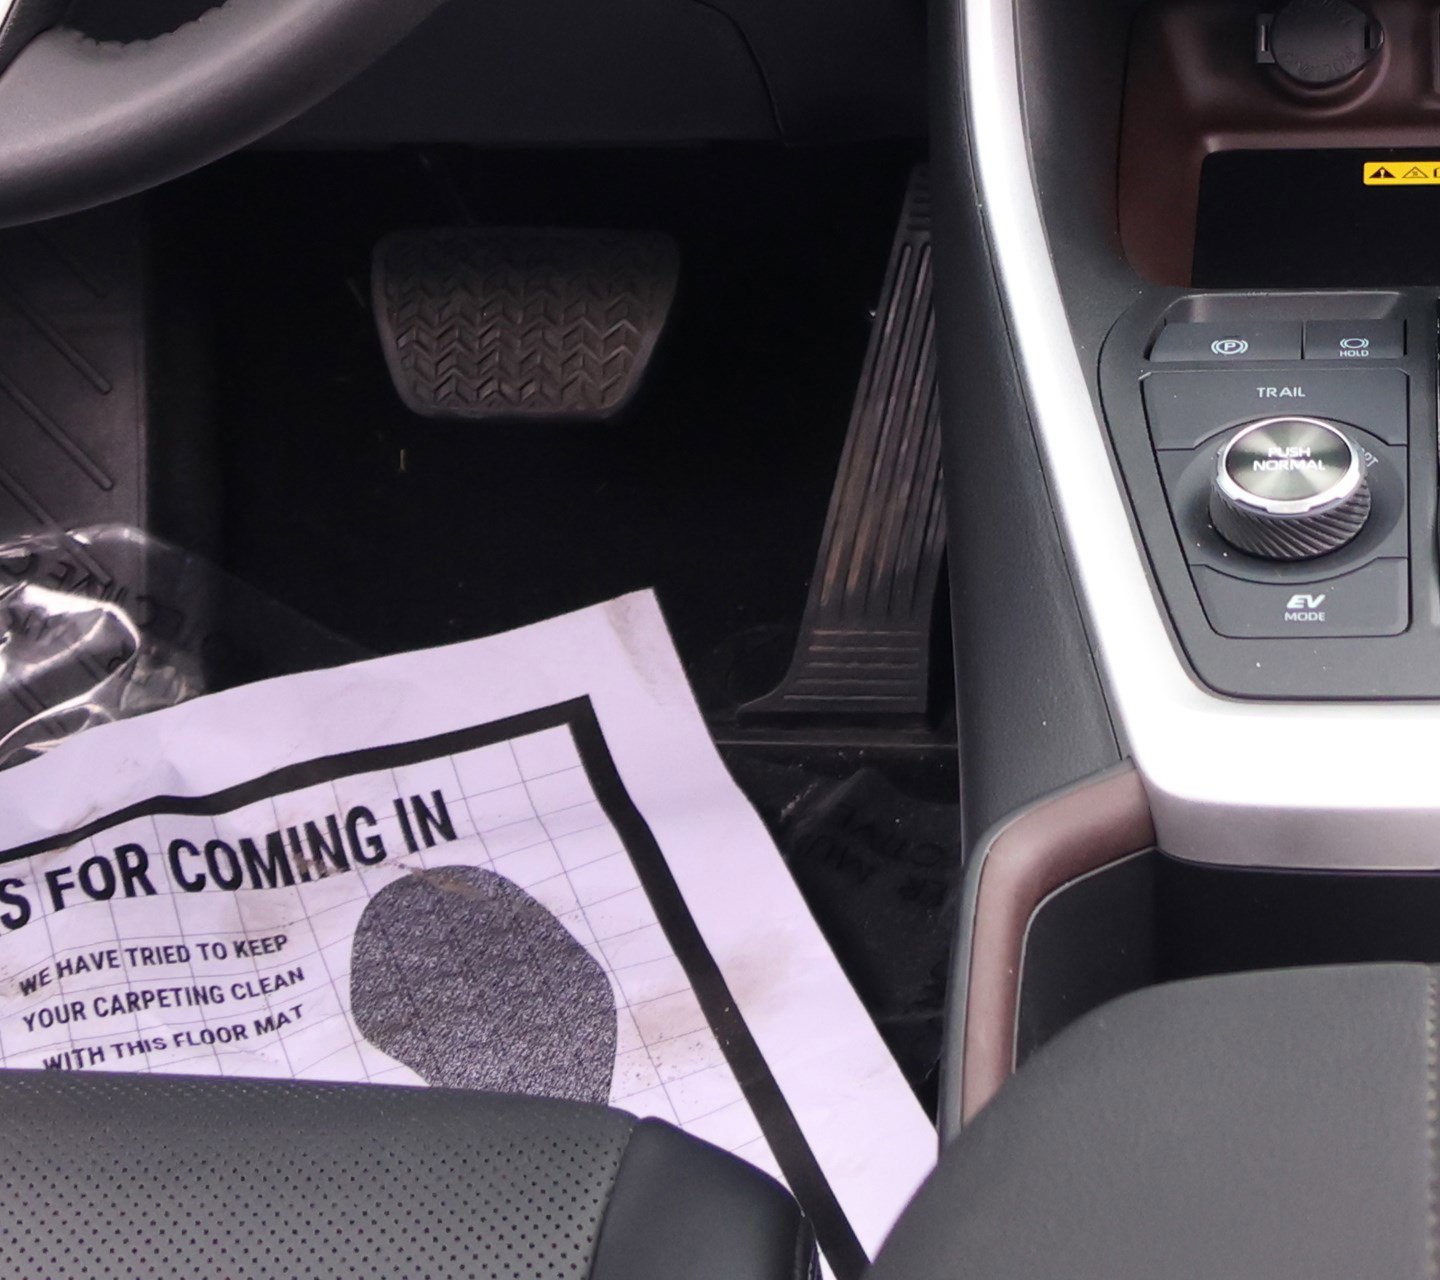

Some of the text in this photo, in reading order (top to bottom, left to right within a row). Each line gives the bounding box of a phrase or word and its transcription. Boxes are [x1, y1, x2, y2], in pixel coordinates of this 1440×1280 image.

[1339, 349, 1370, 358] HOLD
[1256, 386, 1307, 399] TRAIL
[1268, 446, 1311, 457] PUSH
[1253, 459, 1326, 471] NORMAL
[1286, 594, 1326, 611] EV
[1284, 611, 1326, 623] MODE
[45, 842, 159, 912] FOR
[167, 805, 386, 894] COMING
[395, 790, 459, 854] IN
[19, 934, 289, 997] WE HAVE TRIED TO KEEP
[22, 966, 306, 1033] YOUR CARPETING CLEAN
[43, 1003, 304, 1071] WITH THIS FLOOR MAT
